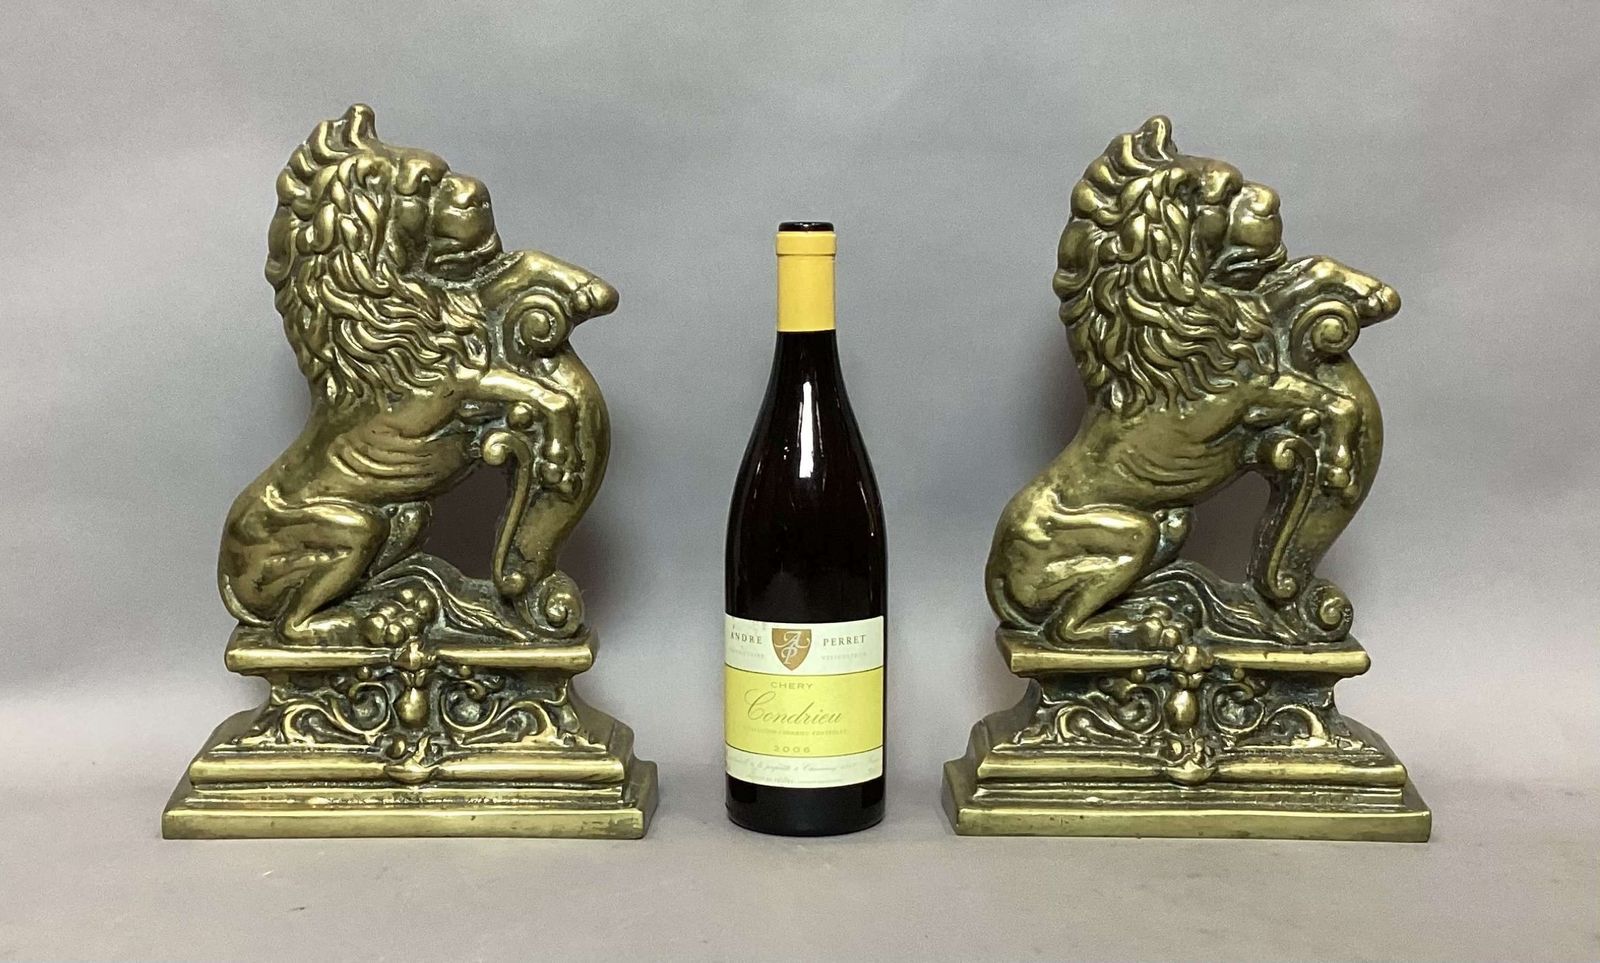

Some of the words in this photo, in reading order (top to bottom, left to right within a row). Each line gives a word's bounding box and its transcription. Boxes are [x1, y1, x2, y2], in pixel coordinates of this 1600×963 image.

[823, 635, 866, 647] PERRET
[770, 681, 814, 690] CHERY
[744, 688, 842, 724] Condrieu
[773, 745, 811, 754] 2006
